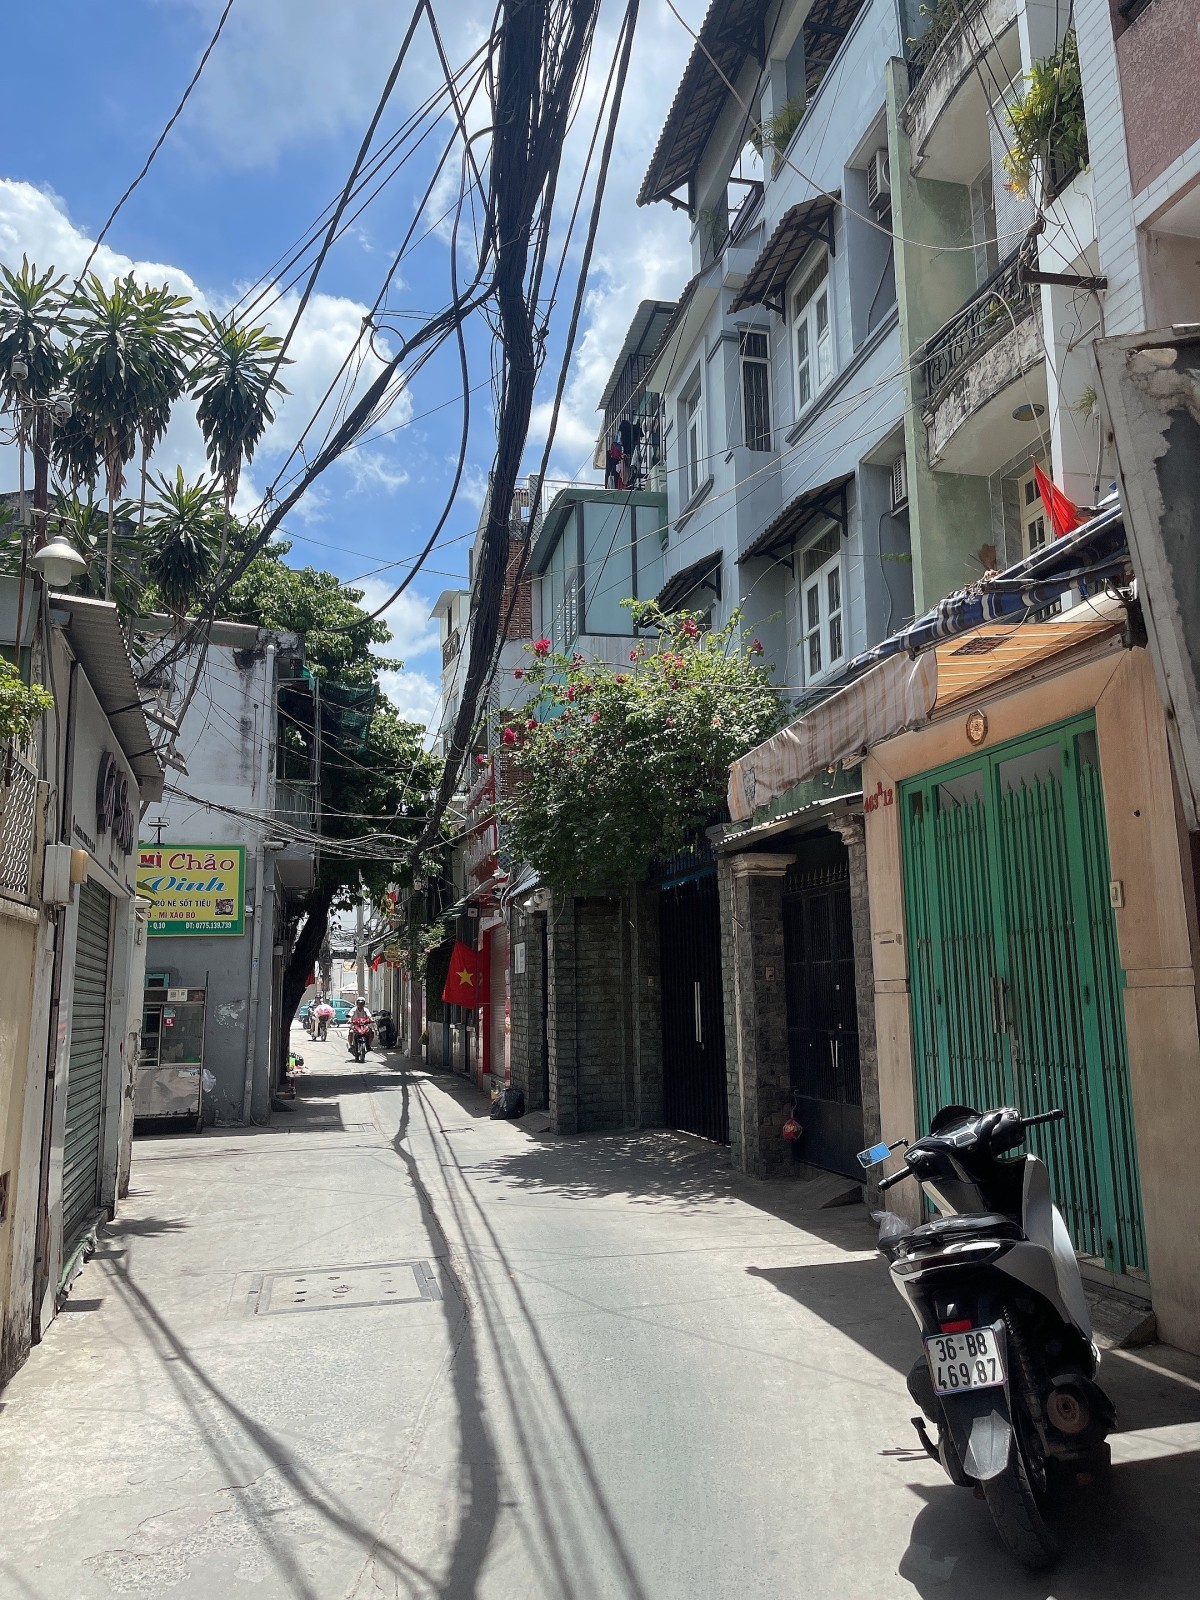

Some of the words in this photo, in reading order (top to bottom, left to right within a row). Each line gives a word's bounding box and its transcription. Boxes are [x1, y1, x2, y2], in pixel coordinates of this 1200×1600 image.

[140, 852, 162, 868] MÌ
[168, 853, 235, 871] Chảo
[143, 876, 227, 892] Vinh
[179, 897, 192, 907] SỐT
[153, 922, 166, 930] Q.10
[935, 1332, 988, 1363] 36-B8
[937, 1357, 996, 1390] 469.87
